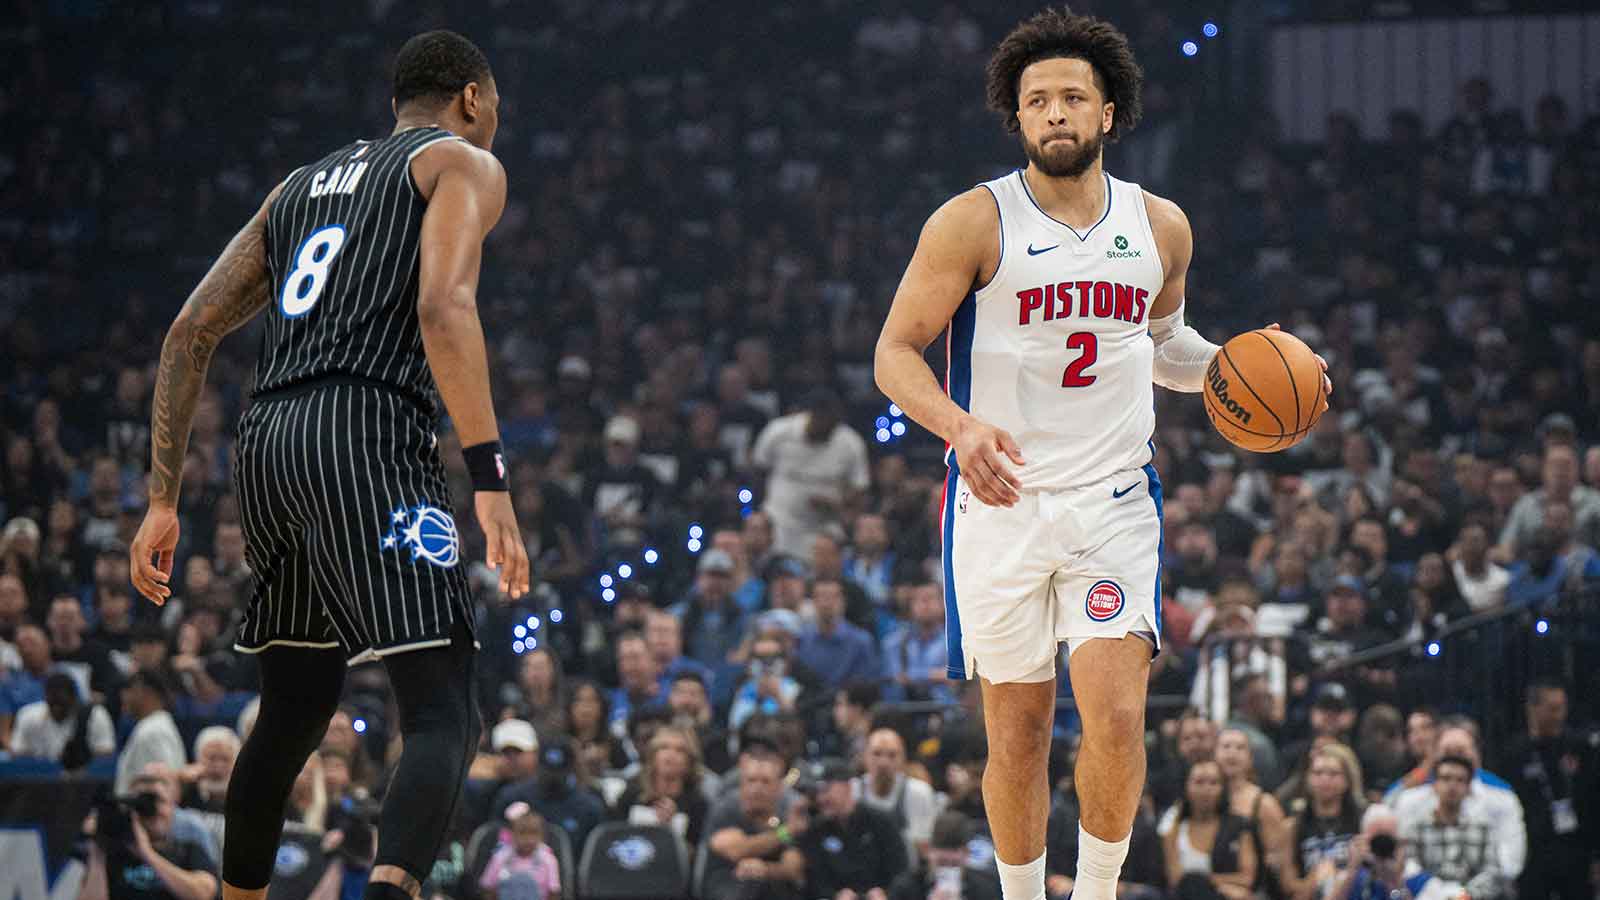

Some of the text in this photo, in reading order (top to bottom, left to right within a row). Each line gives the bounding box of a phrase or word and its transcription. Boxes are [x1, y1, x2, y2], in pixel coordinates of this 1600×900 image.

[309, 161, 369, 198] CAIN
[279, 223, 346, 319] 8
[1106, 250, 1142, 259] StockX
[1016, 281, 1149, 326] PISTONS
[1062, 331, 1098, 388] 2
[1208, 359, 1252, 425] Wilson
